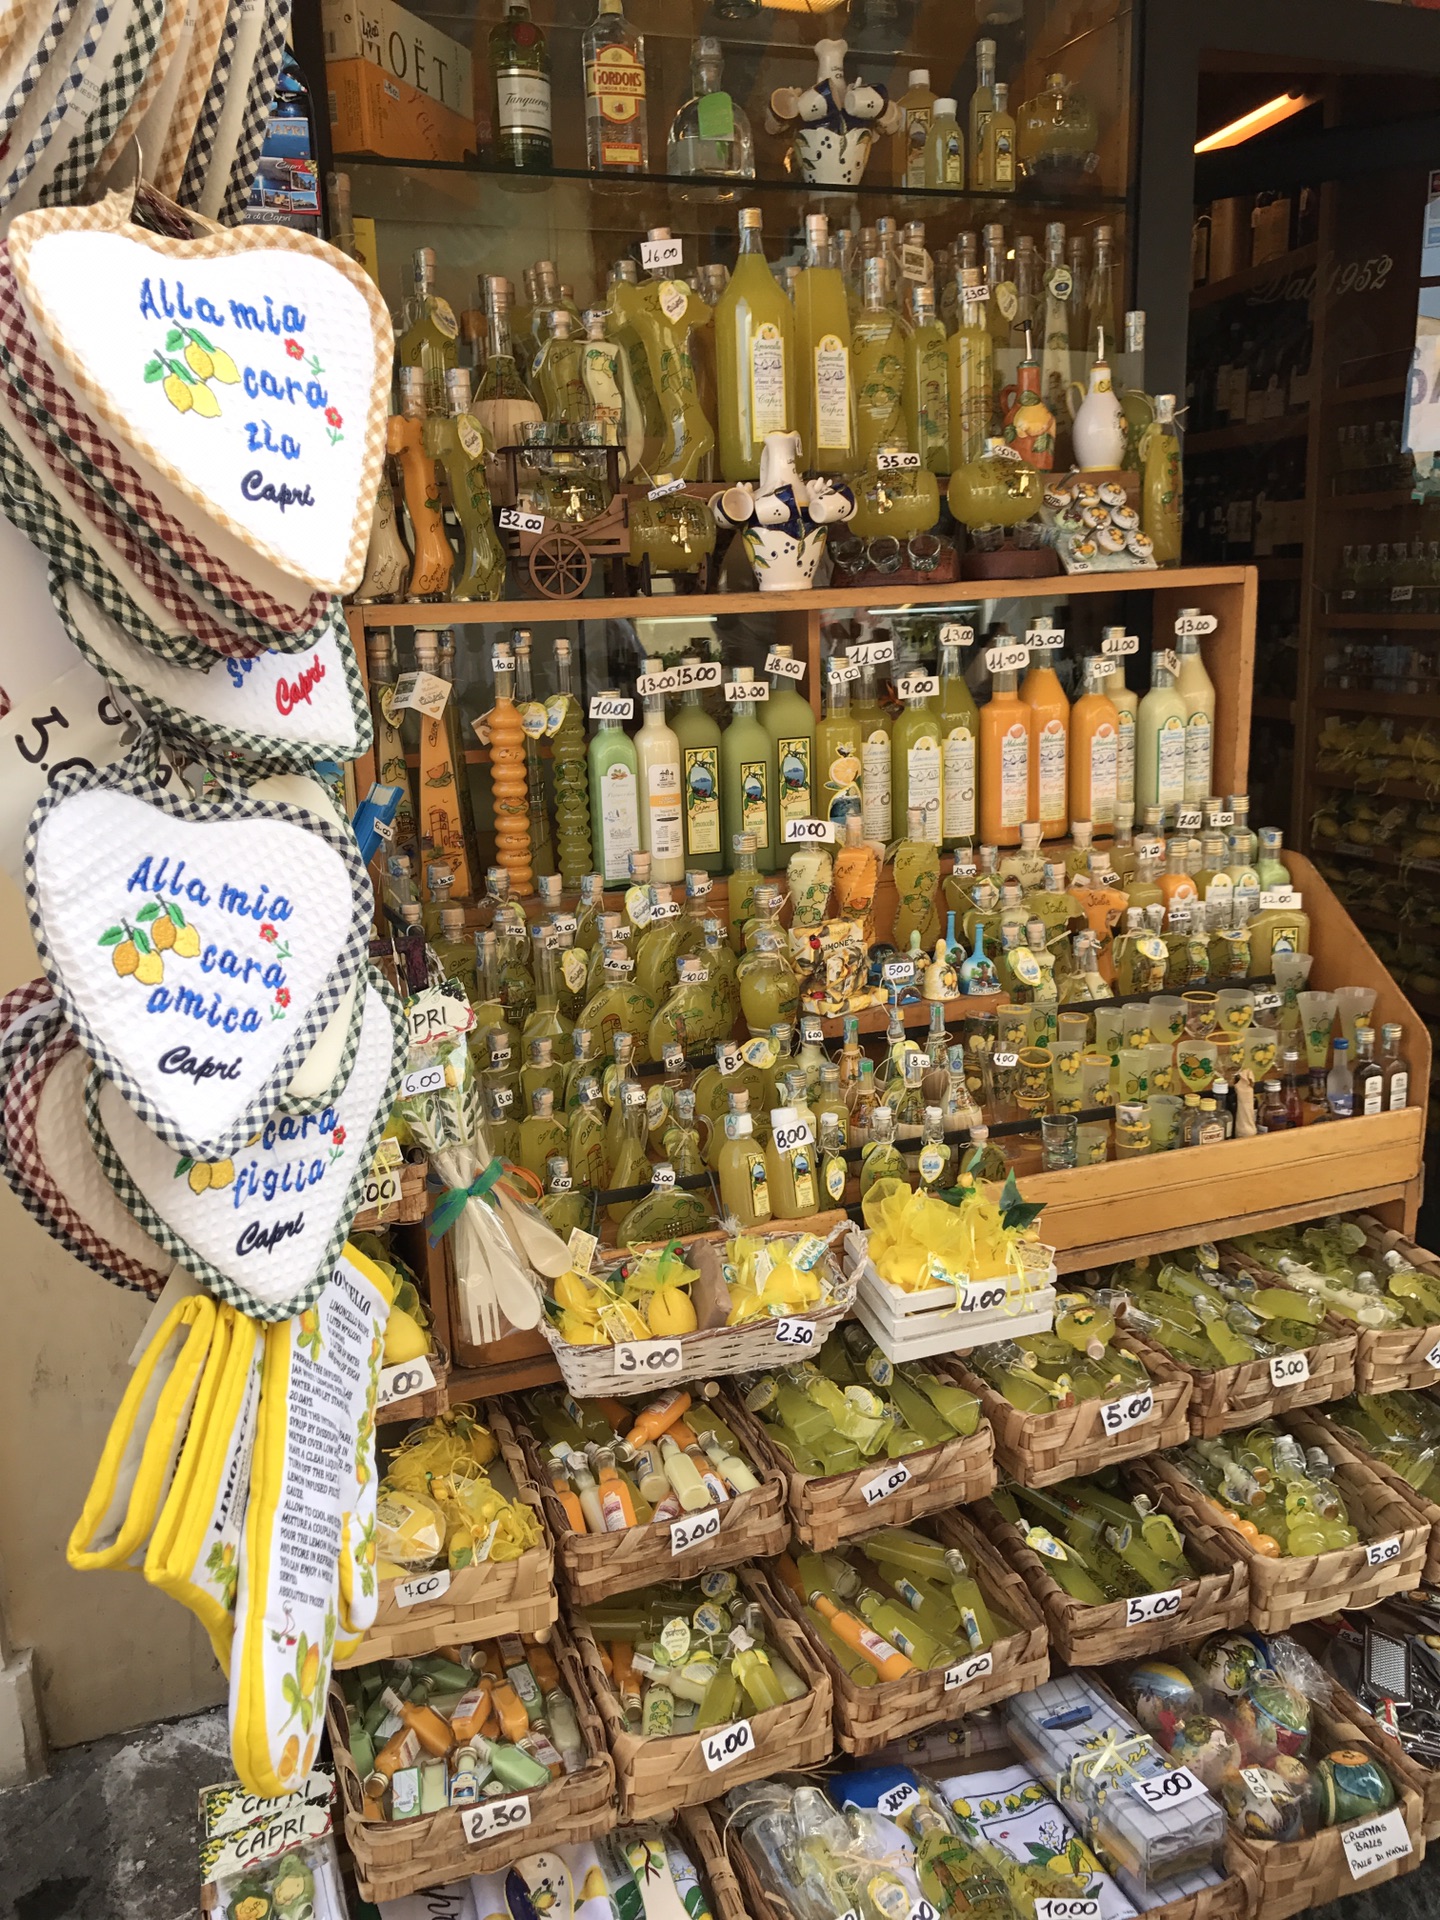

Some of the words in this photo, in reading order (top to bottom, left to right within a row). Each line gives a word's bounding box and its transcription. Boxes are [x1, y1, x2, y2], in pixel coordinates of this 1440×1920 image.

[643, 247, 679, 264] 16.00
[1325, 254, 1393, 296] 1952
[140, 278, 225, 327] Alla
[228, 294, 306, 336] mia
[243, 366, 328, 409] cara
[878, 454, 919, 468] 35.00
[241, 470, 315, 514] Capri
[501, 509, 542, 530] 32.00
[944, 629, 974, 642] 13.00
[1178, 620, 1210, 633] 13.00
[1028, 634, 1063, 646] 13.00
[1106, 639, 1136, 652] 11.00
[850, 647, 893, 665] 11.00
[989, 652, 1025, 669] 11.00
[768, 658, 800, 674] 18.00
[639, 675, 675, 693] 13.00
[677, 666, 717, 687] 15.00
[831, 669, 859, 682] 9.00
[276, 654, 326, 716] Capri
[729, 686, 765, 700] 13.00
[901, 681, 934, 694] 9.00
[592, 701, 631, 716] 10.00
[1180, 815, 1200, 825] 7.00
[1212, 814, 1231, 823] 7.00
[788, 822, 826, 837] 10.00
[127, 856, 210, 906] Alla
[219, 883, 294, 921] mia
[1261, 894, 1291, 904] 12.00
[651, 904, 680, 917] 10.00
[200, 944, 287, 989] cara
[605, 959, 631, 970] 10.00
[683, 971, 708, 981] 10.00
[147, 985, 262, 1033] amica
[408, 1006, 446, 1036] PRI
[807, 1031, 822, 1039] 6.00
[493, 1052, 508, 1060] 8.00
[667, 1057, 682, 1066] 8.00
[912, 1056, 930, 1066] 8.00
[158, 1046, 242, 1085] Capri
[405, 1072, 441, 1092] 6.00
[263, 1106, 338, 1150] cara
[776, 1125, 807, 1148] 8.00
[232, 1159, 325, 1209] figlia
[553, 1179, 570, 1187] 8.00
[653, 1172, 673, 1182] 8.00
[236, 1212, 305, 1256] Capri
[961, 1288, 1006, 1312] 4.00
[776, 1322, 812, 1344] 2.50
[620, 1347, 679, 1371] 3.00
[1274, 1360, 1304, 1378] 5.00
[291, 1377, 311, 1394] WATER
[289, 1390, 299, 1401] 20
[1106, 1396, 1151, 1428] 5.00
[289, 1416, 306, 1430] SYRUP
[307, 1423, 316, 1434] BY
[289, 1429, 307, 1444] WATER
[308, 1437, 323, 1451] OVER
[306, 1451, 324, 1465] CLEAR
[312, 1467, 325, 1479] THE
[305, 1479, 328, 1494] INFUSED
[868, 1470, 907, 1500] 4.00
[284, 1500, 303, 1516] ALLOW
[304, 1505, 312, 1517] TO
[312, 1509, 326, 1522] COOL
[281, 1513, 307, 1529] MIXTURE
[280, 1527, 296, 1541] POUR
[297, 1532, 308, 1545] THE
[308, 1535, 327, 1550] LEMON
[675, 1517, 718, 1549] 3.00
[291, 1545, 309, 1559] STORE
[310, 1551, 316, 1561] IN
[1369, 1544, 1400, 1565] 5.00
[300, 1562, 317, 1577] ENJOY
[404, 1577, 439, 1598] 7.00
[1129, 1596, 1181, 1623] 5.00
[945, 1658, 989, 1685] 4.00
[708, 1726, 749, 1762] 4.00
[1141, 1771, 1192, 1801] 5.00
[471, 1804, 527, 1839] 2.50
[235, 1815, 305, 1858] CAPRI
[1353, 1838, 1383, 1852] BALLS
[1350, 1857, 1373, 1871] PALLE
[1376, 1853, 1385, 1861] DI
[1041, 1901, 1098, 1918] 10.00
